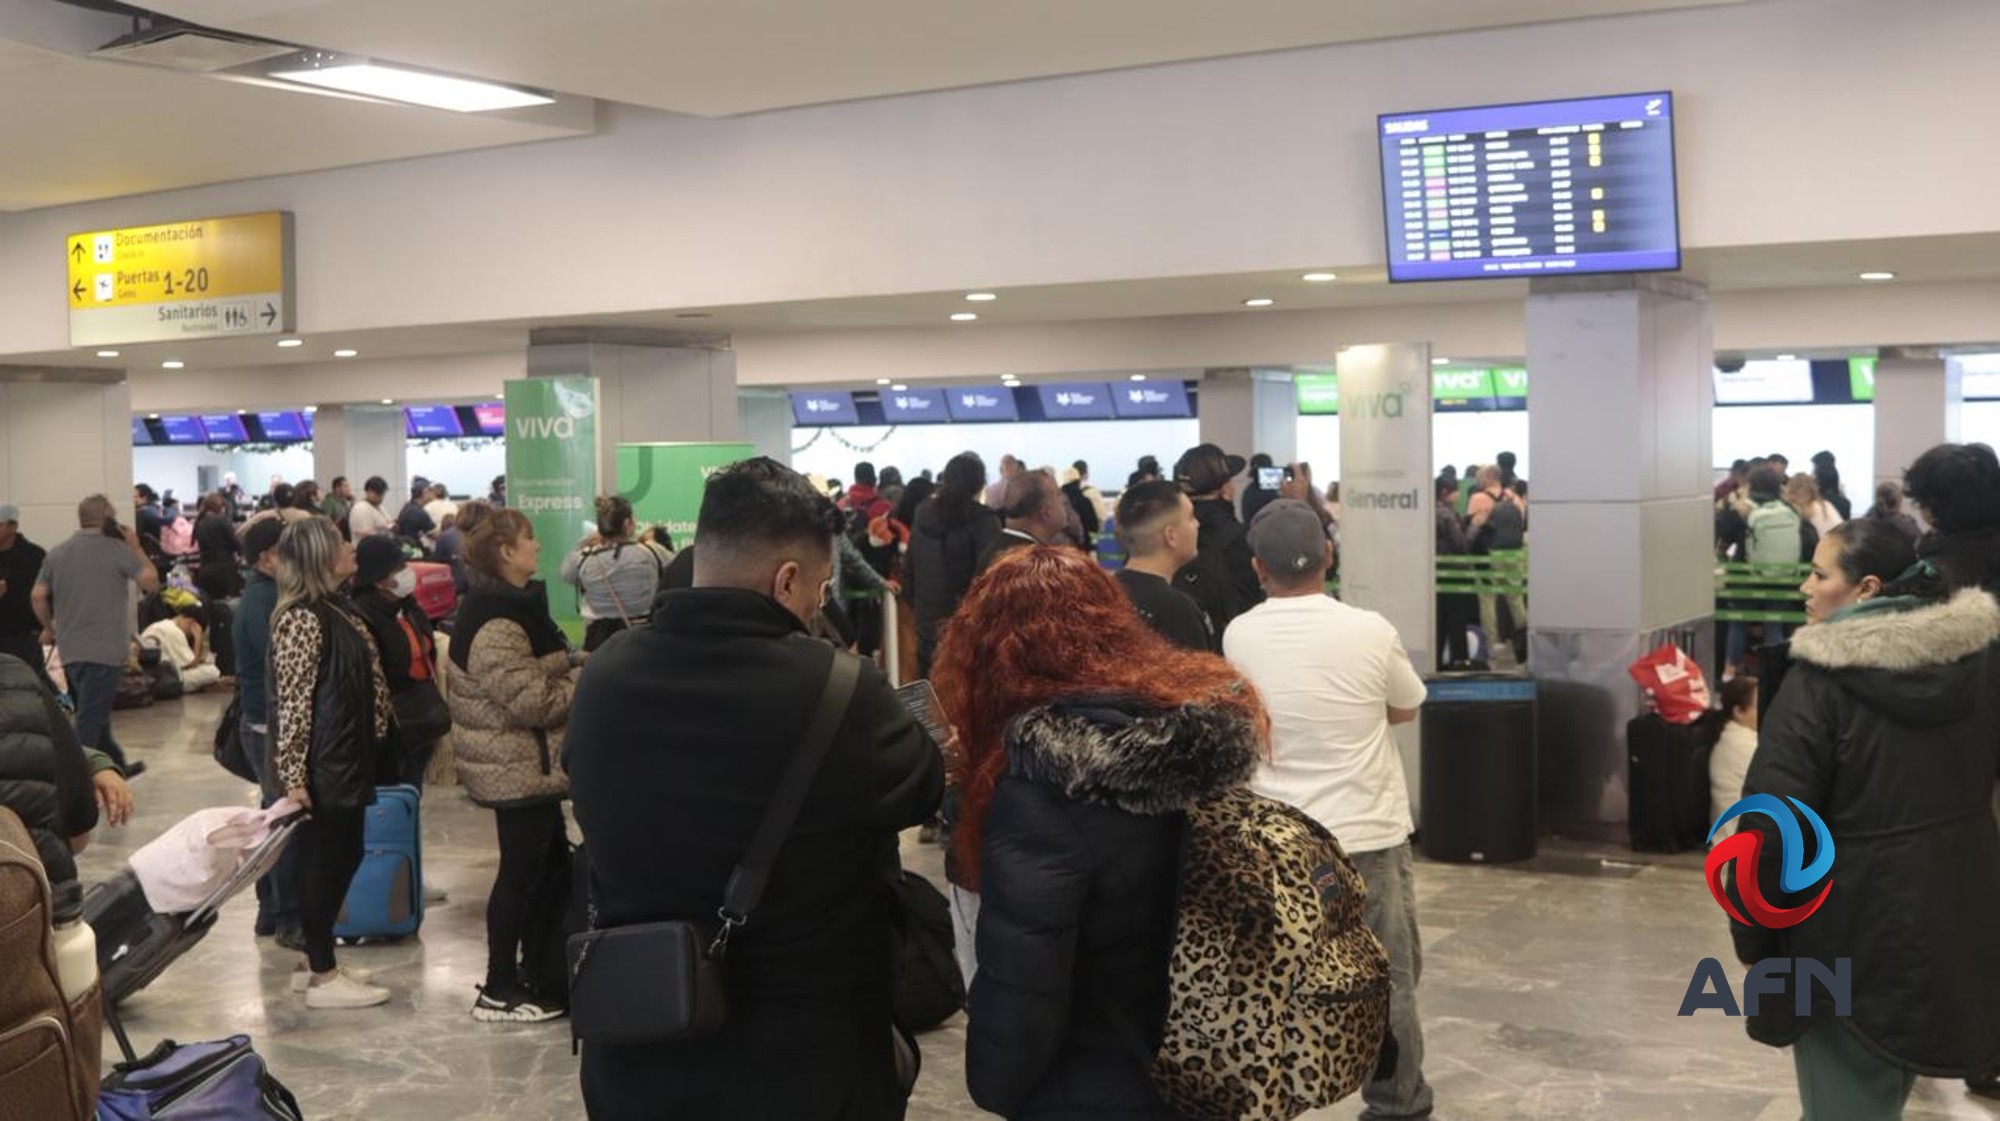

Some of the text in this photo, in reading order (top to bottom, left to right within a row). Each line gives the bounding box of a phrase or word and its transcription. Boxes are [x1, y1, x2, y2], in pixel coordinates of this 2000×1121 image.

[116, 226, 204, 247] Documentación
[117, 268, 209, 294] Puertas 1-20
[158, 303, 218, 321] Sanitarios
[1348, 392, 1402, 418] viva
[515, 416, 575, 439] viva
[518, 494, 583, 513] Express
[1347, 488, 1418, 510] General
